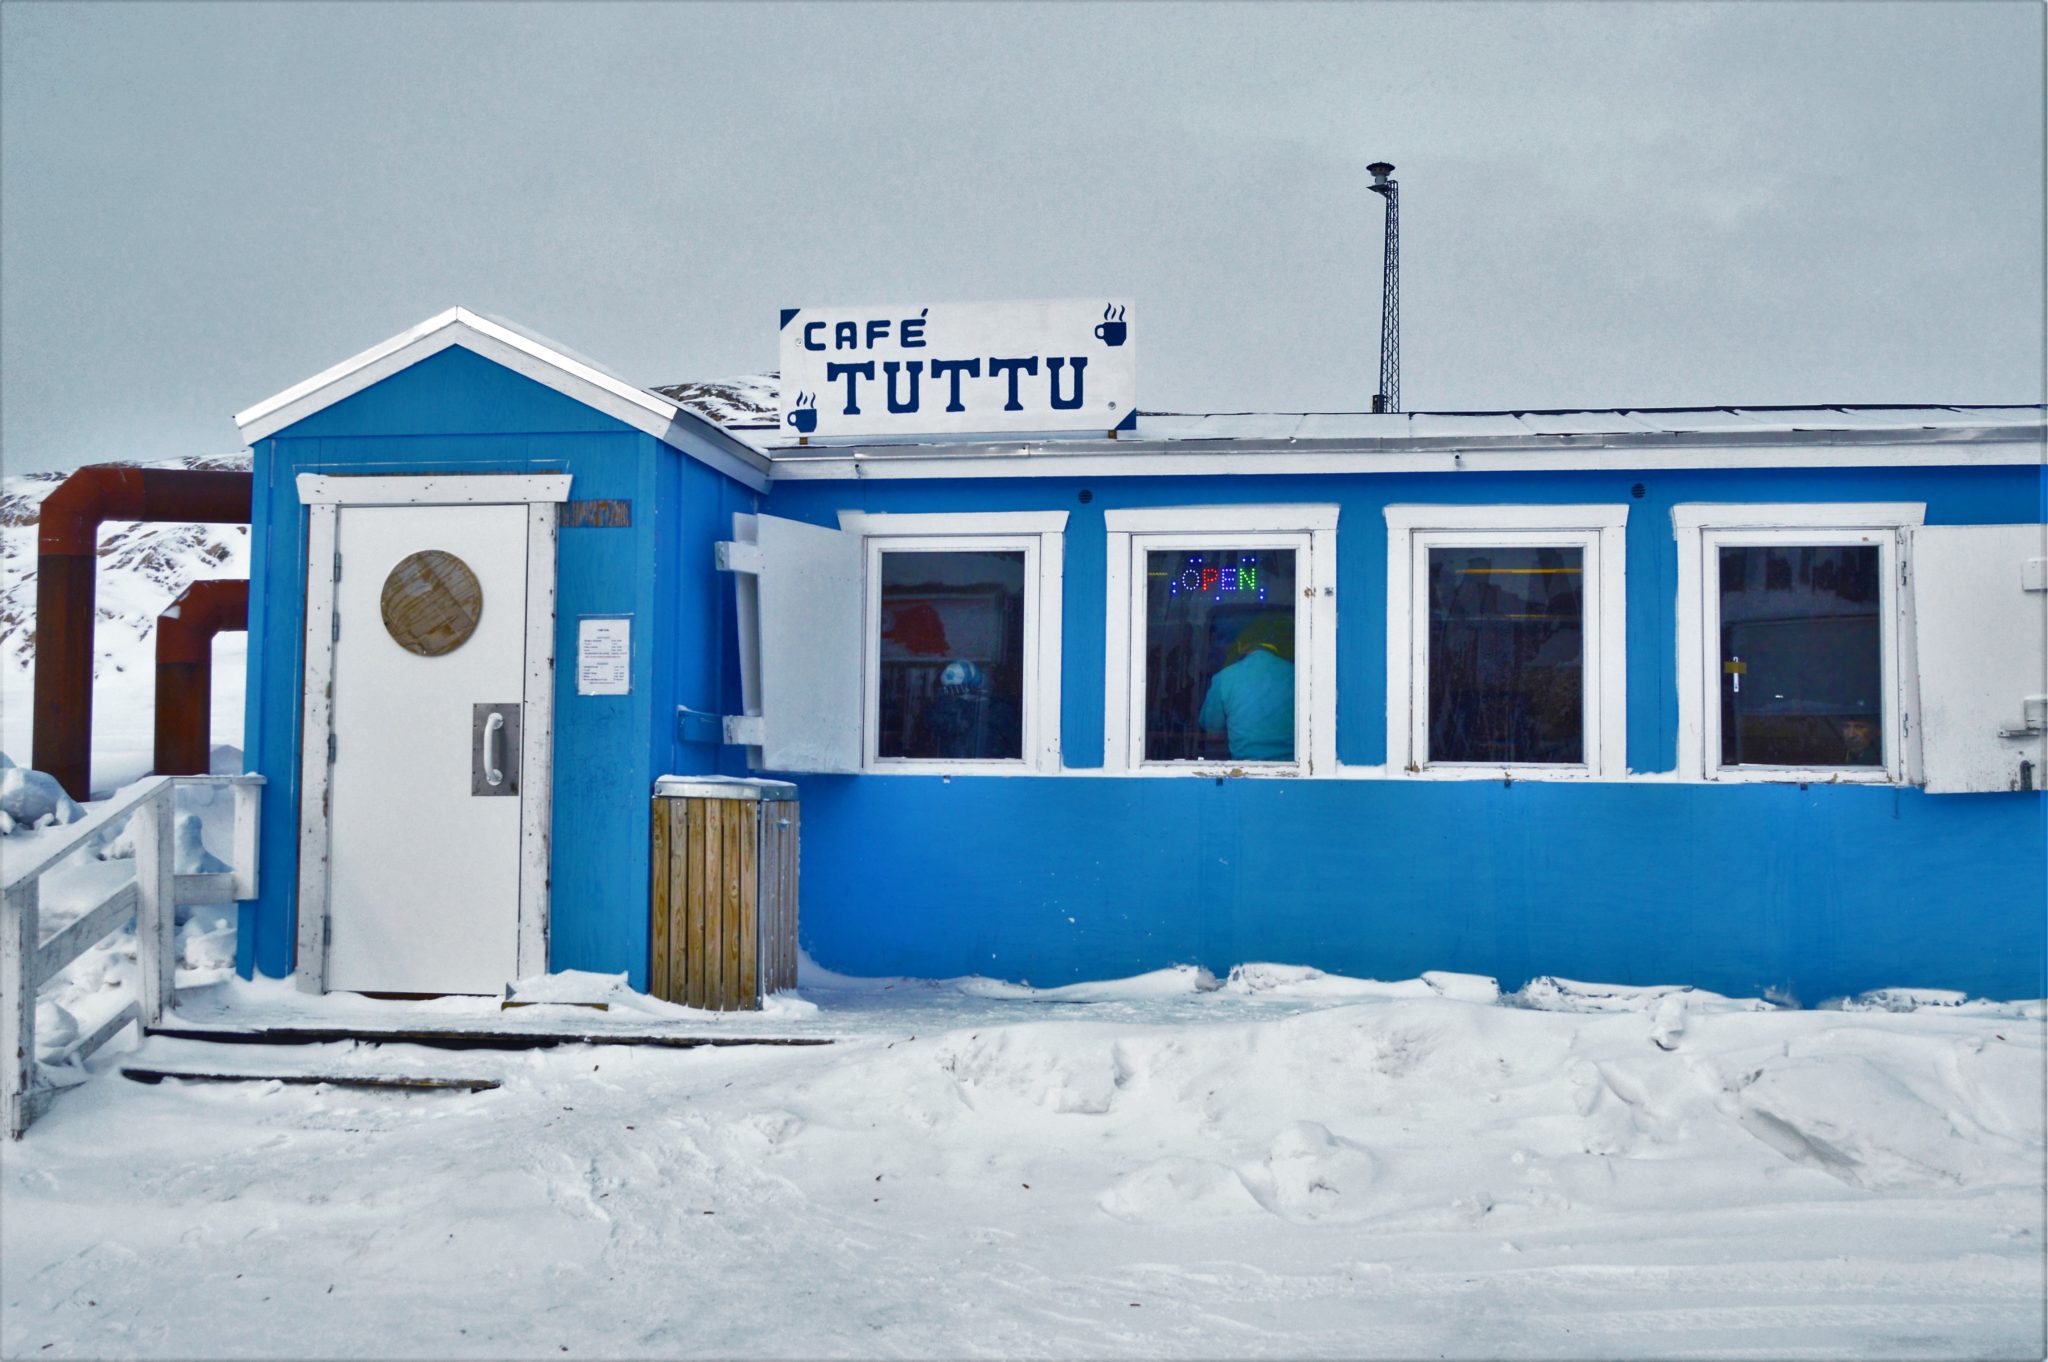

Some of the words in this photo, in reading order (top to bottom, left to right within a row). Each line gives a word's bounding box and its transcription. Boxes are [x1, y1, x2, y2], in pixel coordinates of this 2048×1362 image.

[803, 308, 929, 351] CAFÉ
[826, 355, 1088, 415] TUTTU
[1182, 567, 1257, 591] OPEN
